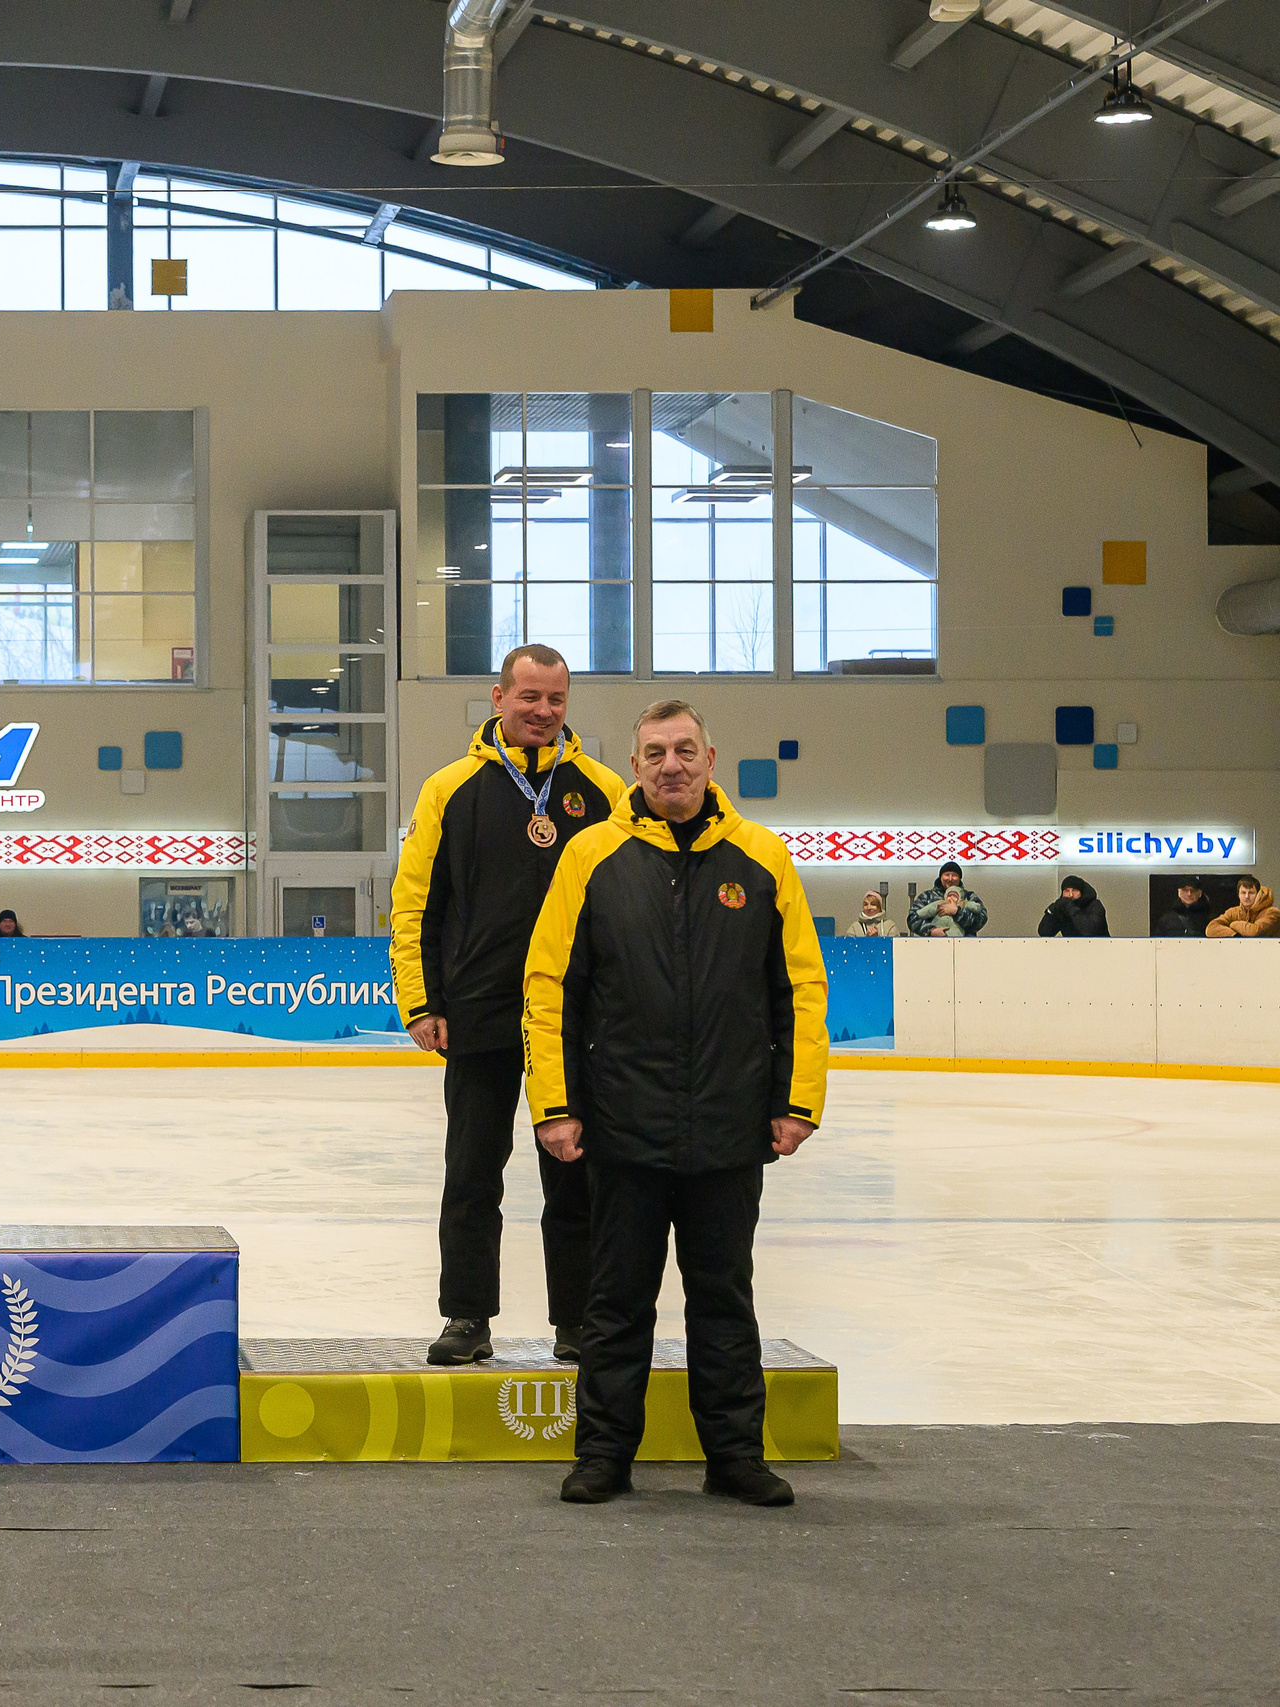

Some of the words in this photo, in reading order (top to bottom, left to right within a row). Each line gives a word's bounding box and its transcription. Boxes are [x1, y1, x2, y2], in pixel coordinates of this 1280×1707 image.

[1078, 832, 1238, 859] silichy.by
[523, 997, 534, 1077] BEARUS
[511, 1381, 566, 1416] III
